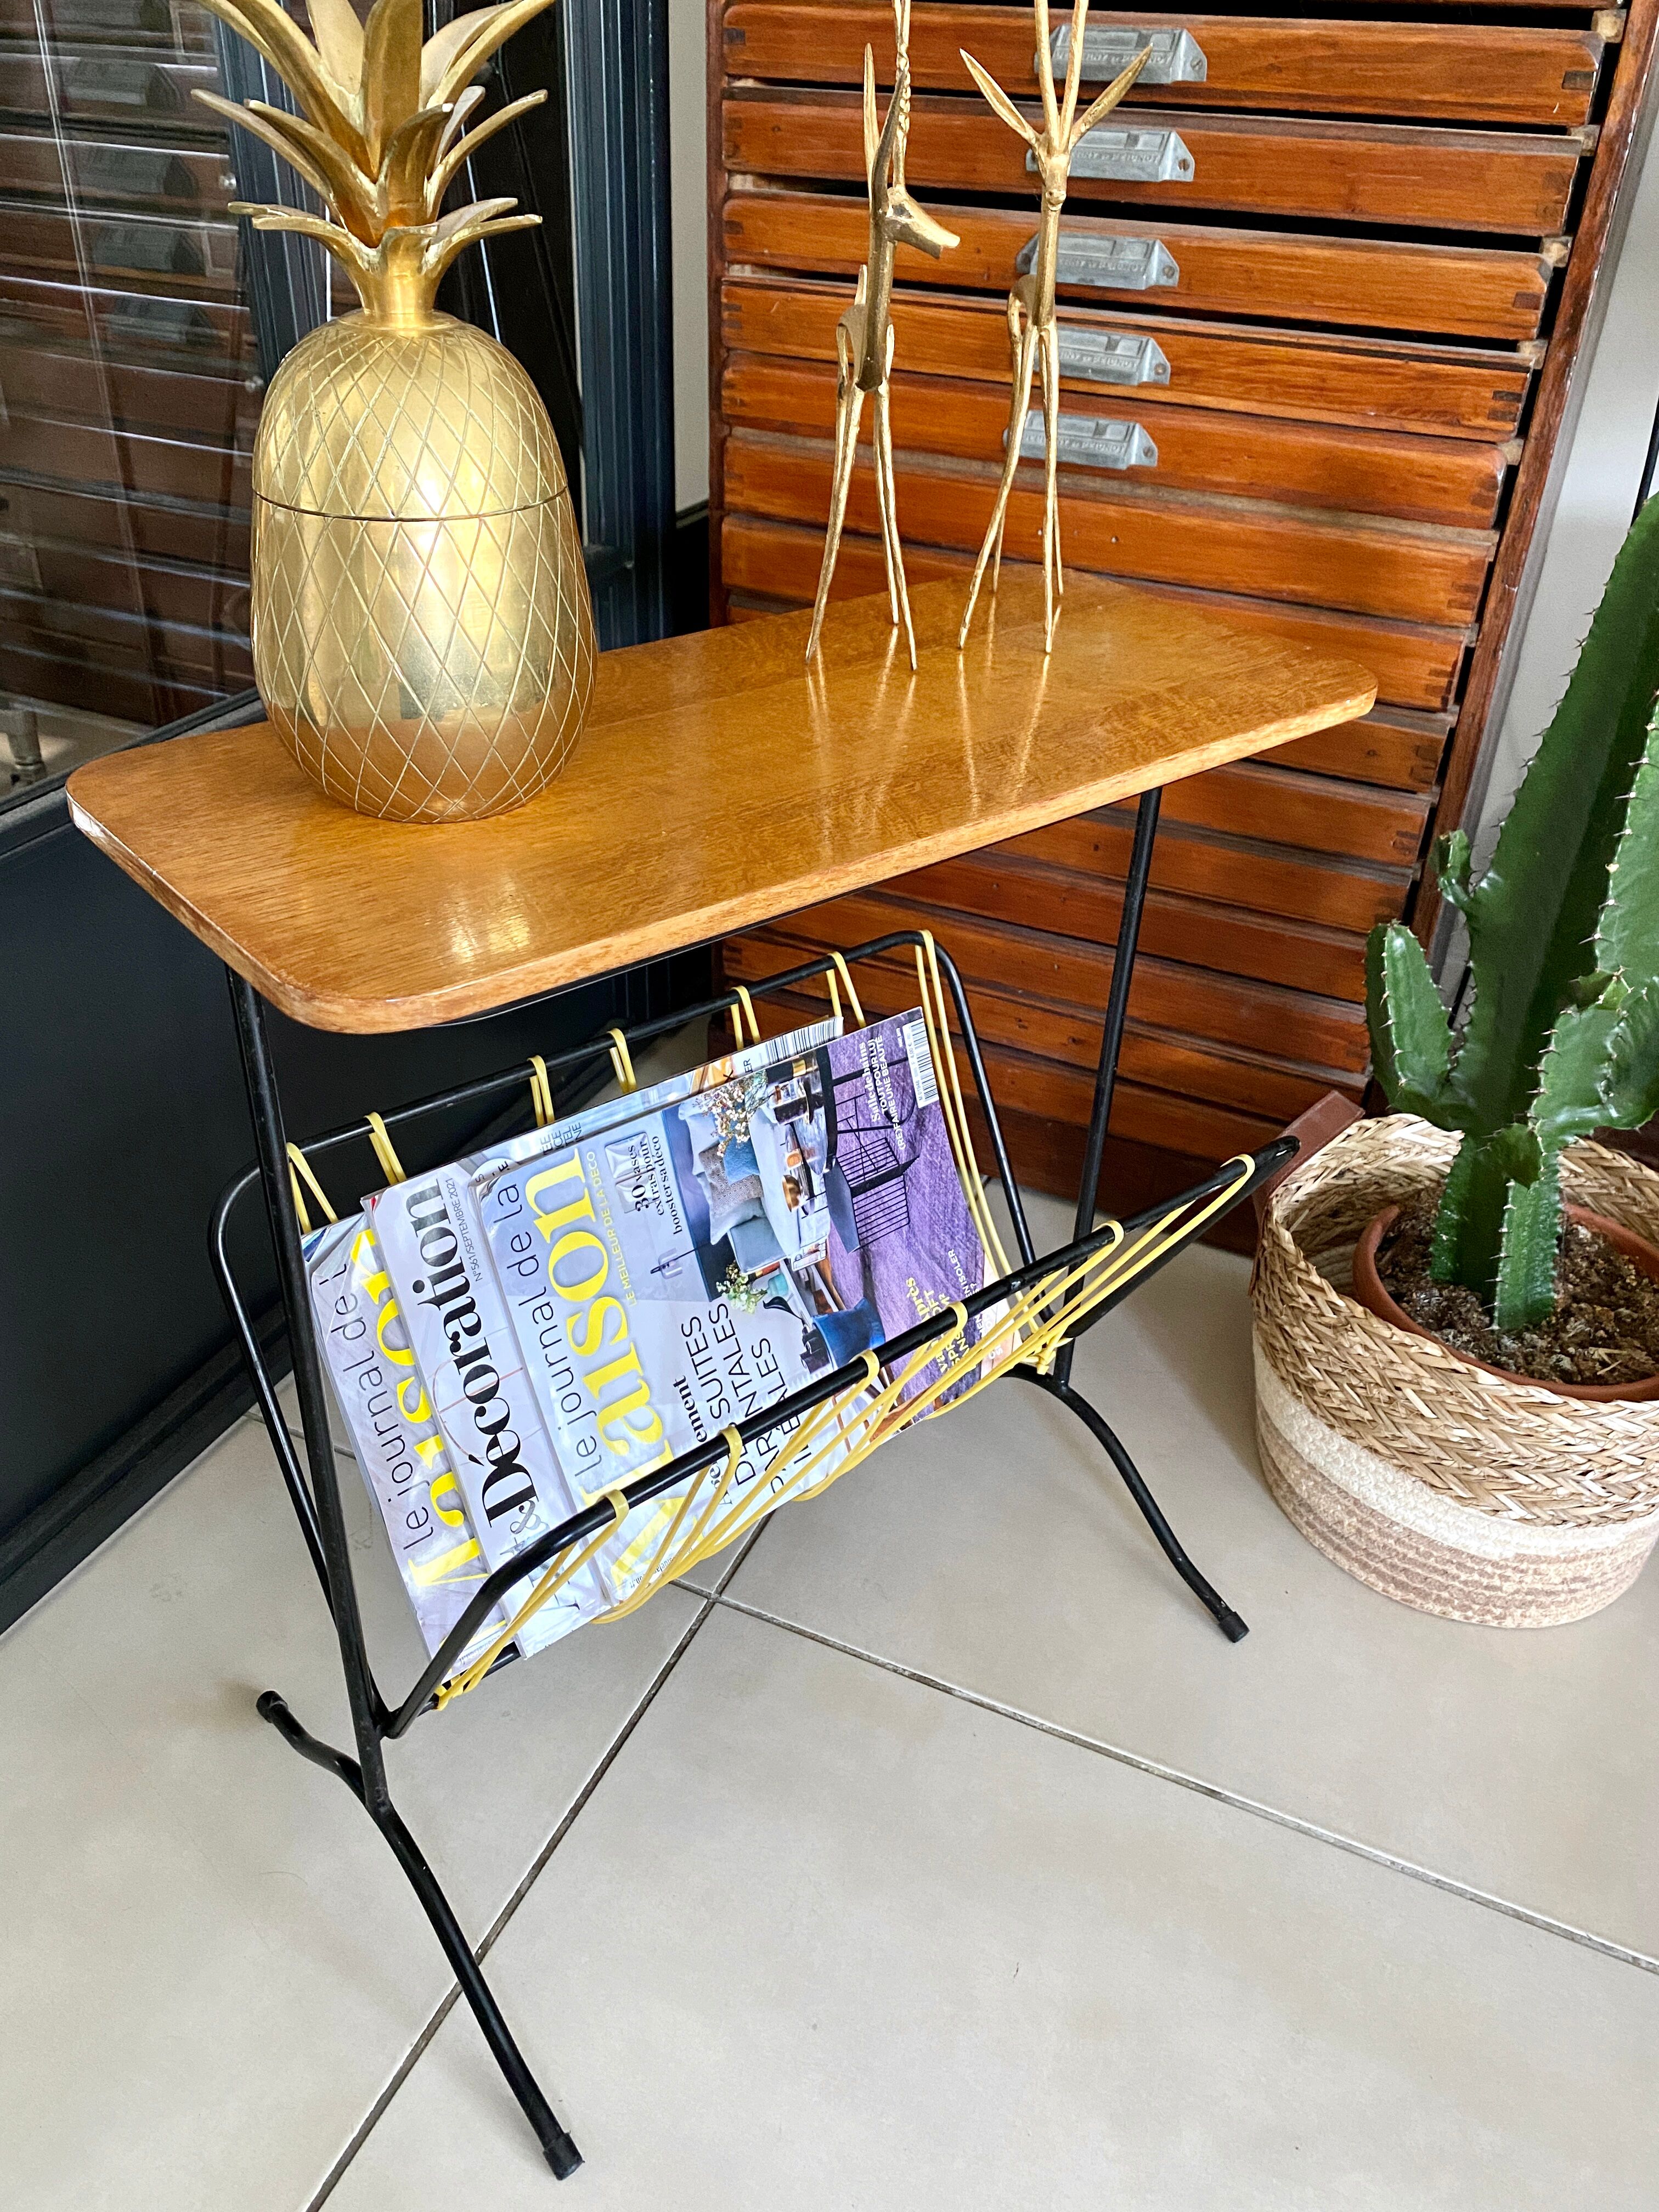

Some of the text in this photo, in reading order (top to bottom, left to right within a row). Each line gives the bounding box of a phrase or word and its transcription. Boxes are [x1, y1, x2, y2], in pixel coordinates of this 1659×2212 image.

[859, 1042, 871, 1077] bains
[871, 1057, 884, 1089] POUR
[864, 1076, 872, 1090] de
[876, 1091, 888, 1114] TOUT
[883, 1077, 894, 1099] UNE
[445, 1177, 459, 1198] 2021
[596, 1190, 607, 1206] LA
[628, 1145, 649, 1212] 30 vases
[640, 1141, 664, 1216] extras pour
[652, 1136, 682, 1235] booster sa déco
[601, 1210, 613, 1227] DE
[607, 1228, 632, 1289] MEILLEUR
[947, 1248, 968, 1287] ISOLER
[331, 1293, 366, 1340] de
[625, 1290, 637, 1307] LE
[494, 1183, 602, 1477] le journal de la
[681, 1316, 730, 1419] SUITES
[343, 1350, 431, 1502] journal
[403, 1505, 434, 1550] le
